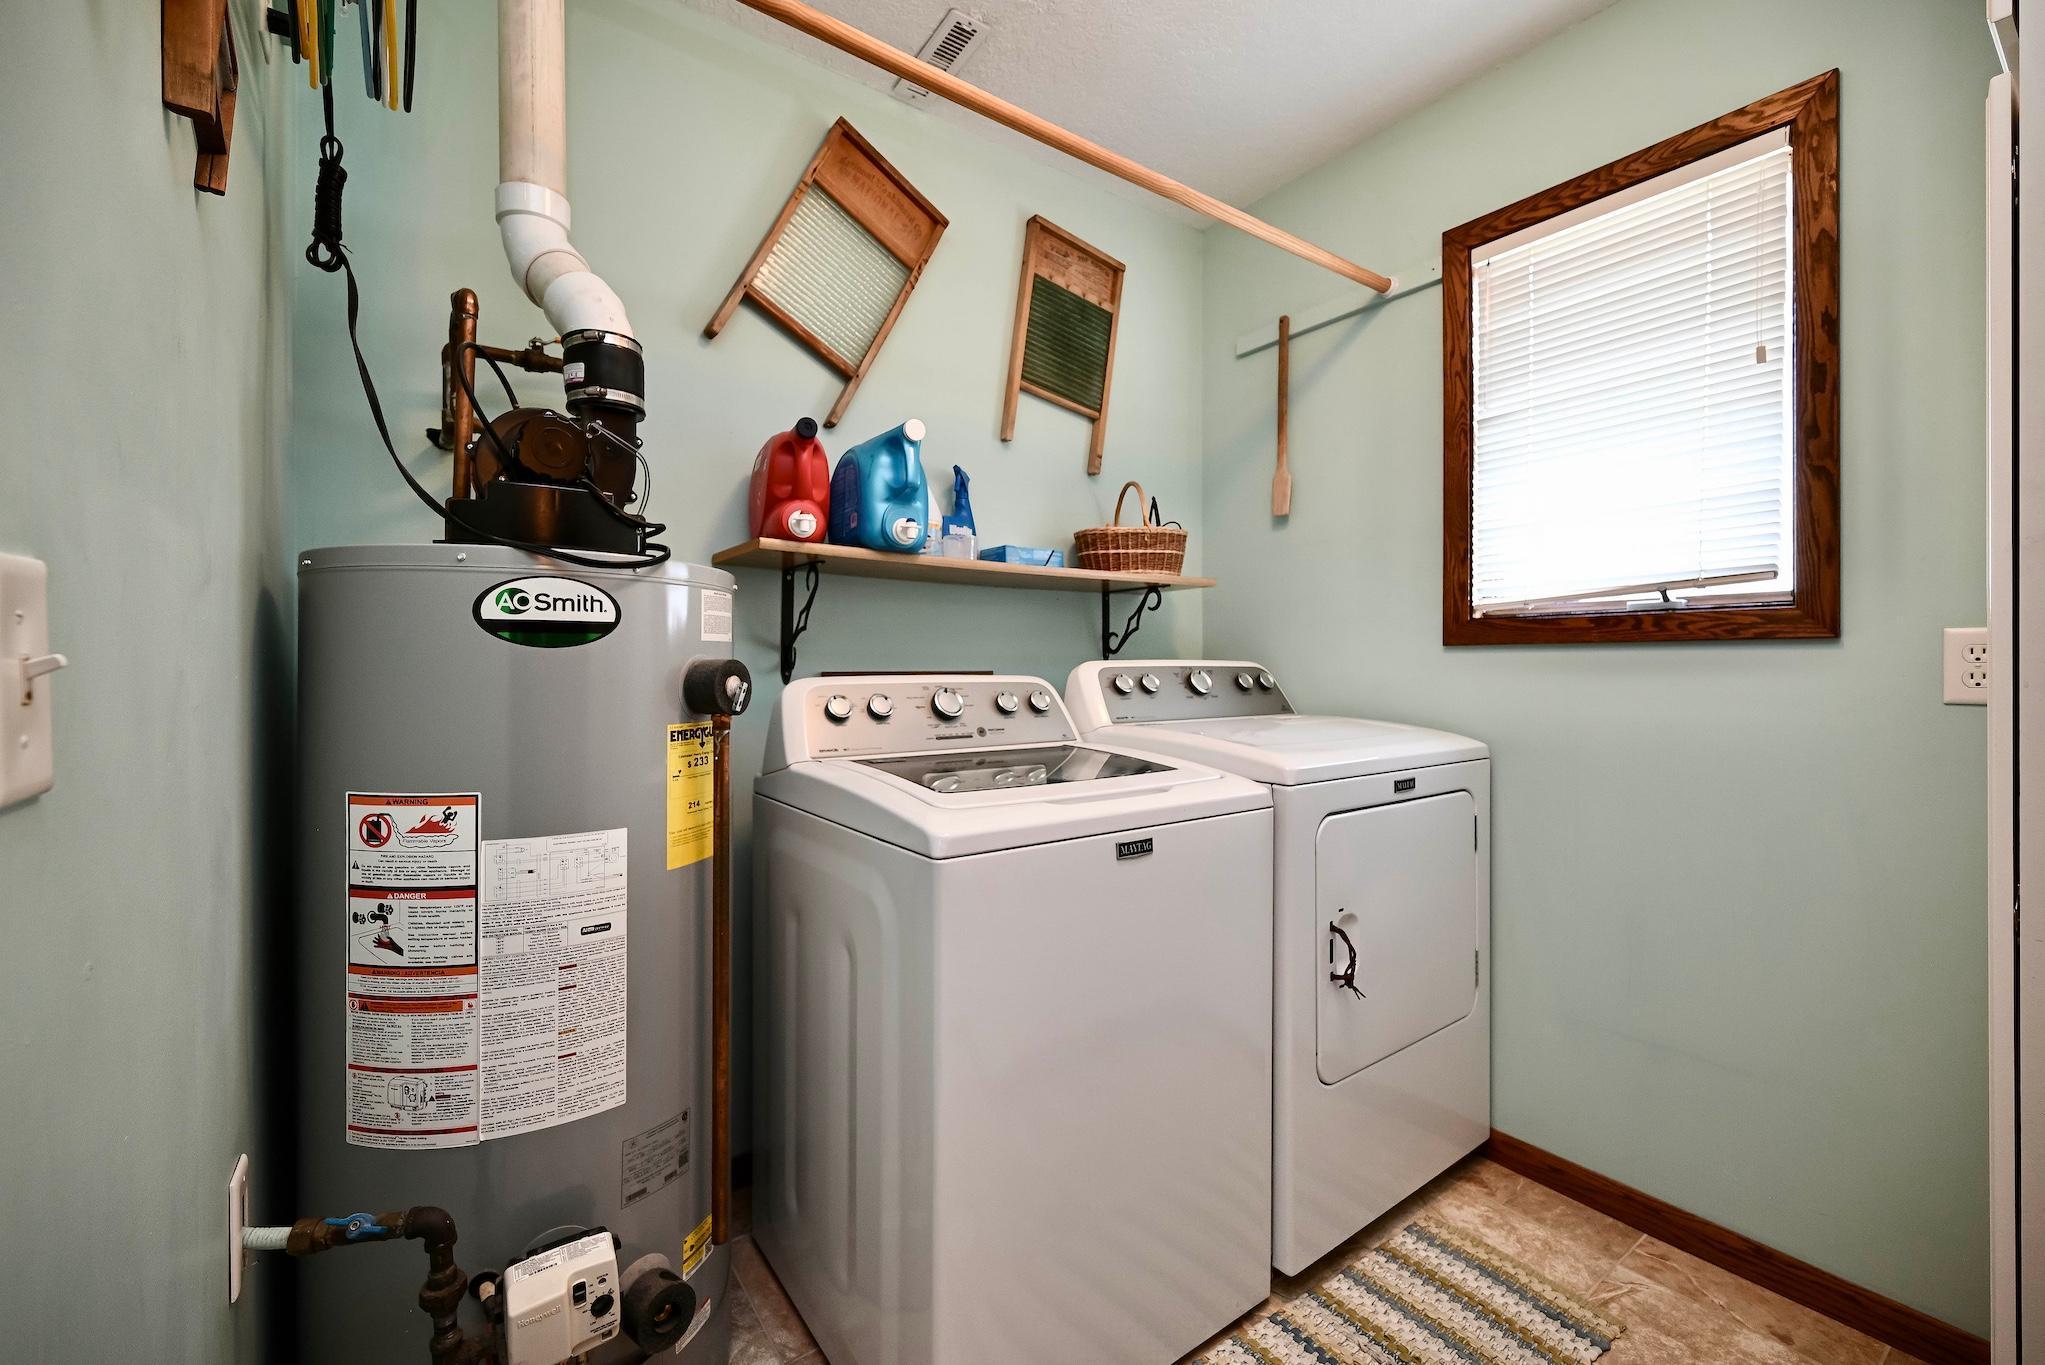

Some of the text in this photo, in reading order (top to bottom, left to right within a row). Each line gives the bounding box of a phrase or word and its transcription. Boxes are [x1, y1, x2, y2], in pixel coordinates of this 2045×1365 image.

[694, 755, 709, 767] 233
[392, 798, 428, 806] WARNING
[688, 800, 701, 809] 214
[1120, 841, 1152, 855] MAYTAG
[393, 892, 427, 900] DANGER
